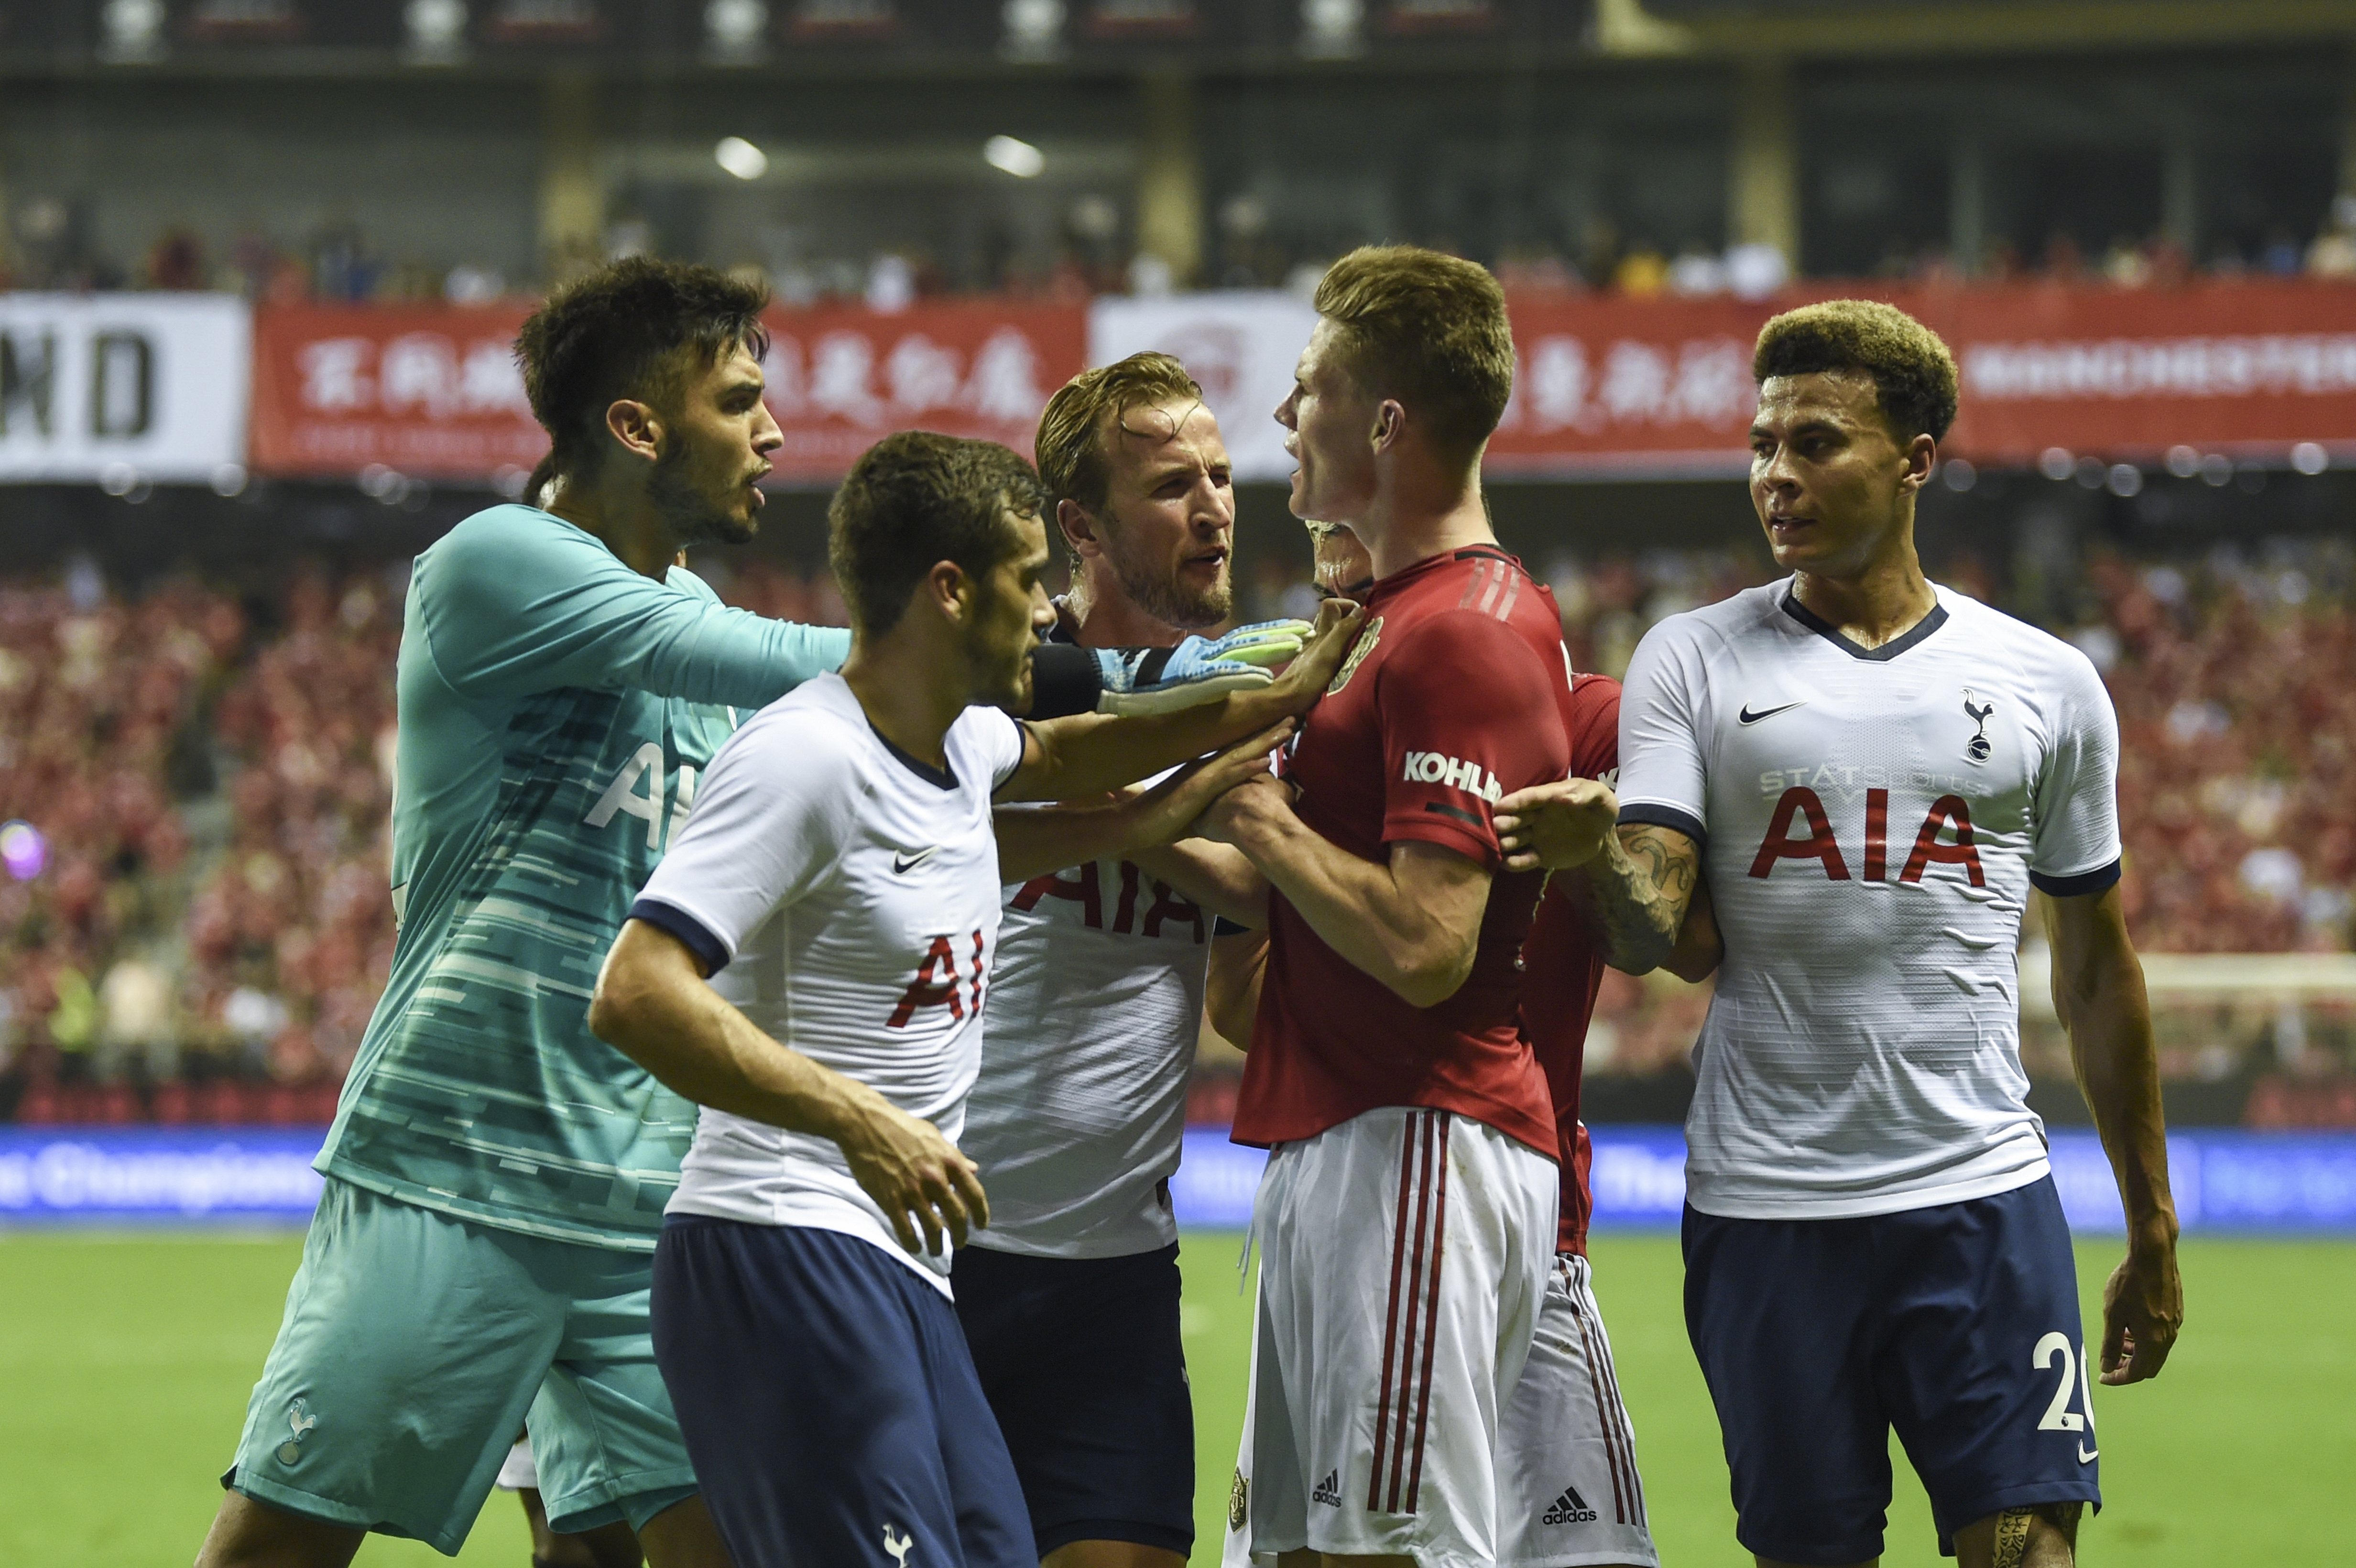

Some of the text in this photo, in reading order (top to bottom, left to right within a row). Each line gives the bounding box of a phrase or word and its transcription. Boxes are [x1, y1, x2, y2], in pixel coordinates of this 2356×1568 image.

[583, 742, 695, 855] AI
[1748, 786, 1985, 887] AIA
[886, 930, 983, 1027] AI
[1312, 1491, 1342, 1508] addas
[1542, 1509, 1597, 1525] adidas
